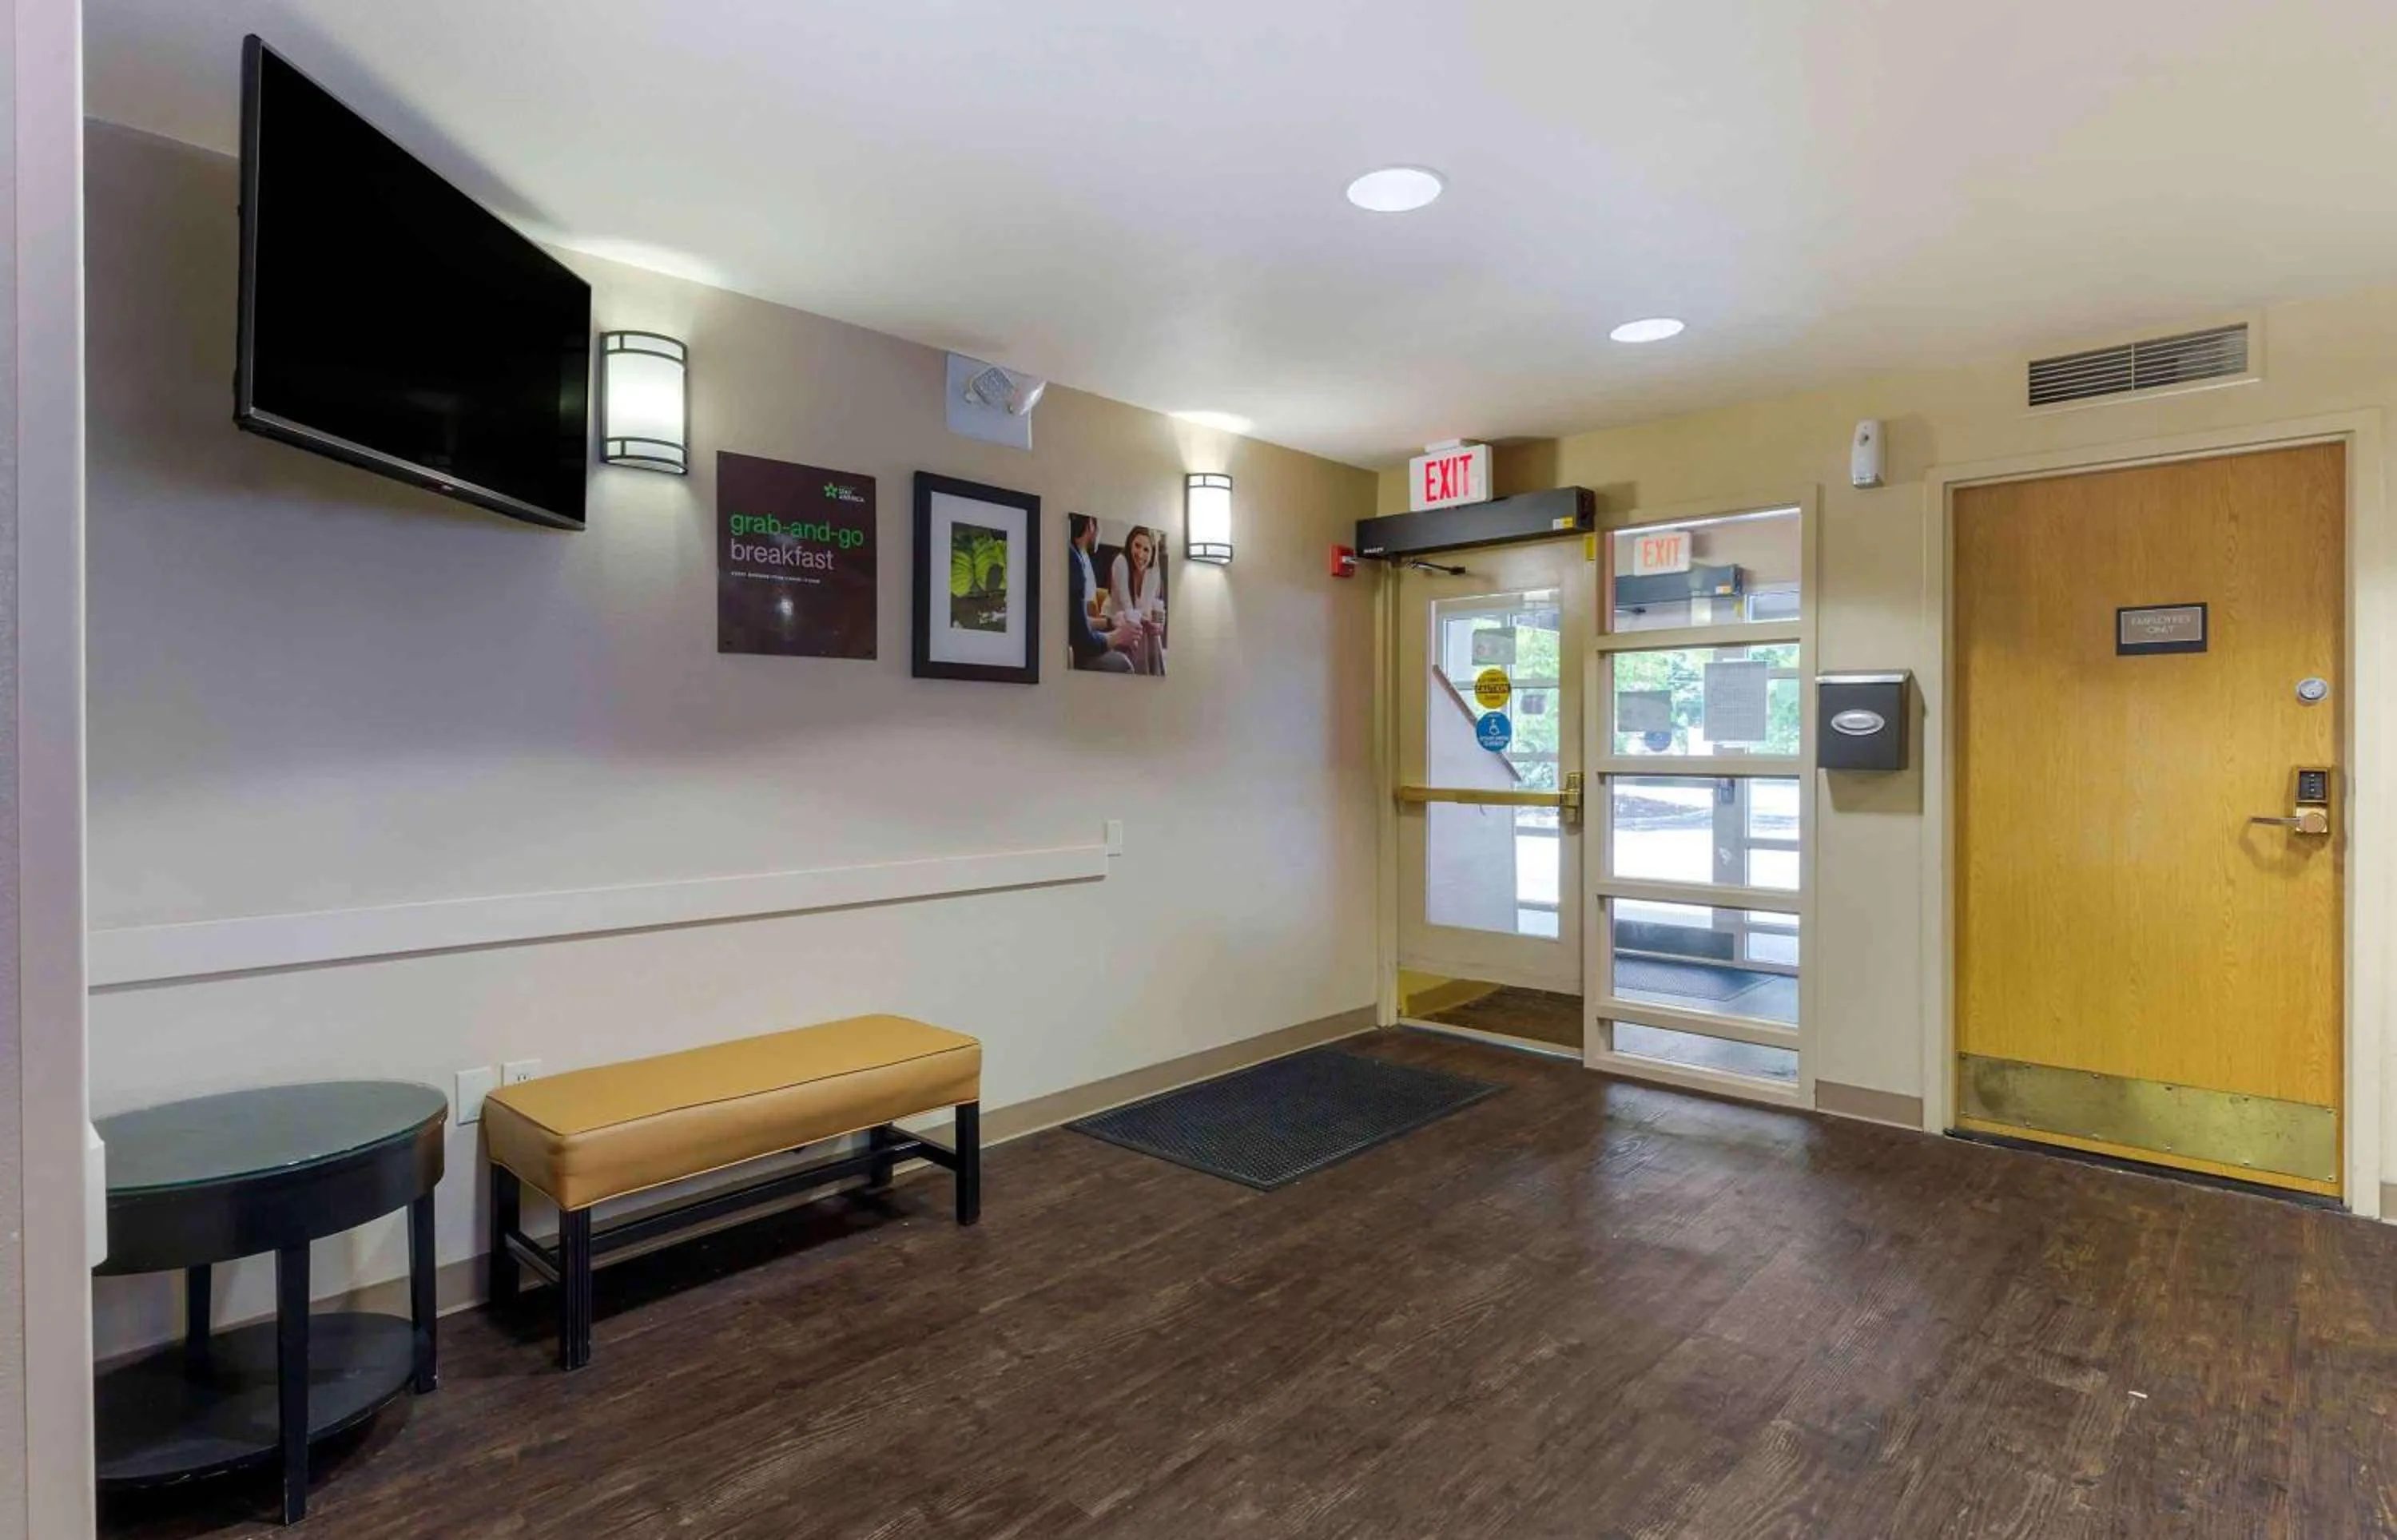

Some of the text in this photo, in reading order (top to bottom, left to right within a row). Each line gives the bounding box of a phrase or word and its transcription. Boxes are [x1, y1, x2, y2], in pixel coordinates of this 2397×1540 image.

[1425, 454, 1473, 503] EXIT
[730, 512, 864, 549] grab-and-go
[730, 538, 834, 570] breakfast
[1642, 537, 1681, 572] EXIT
